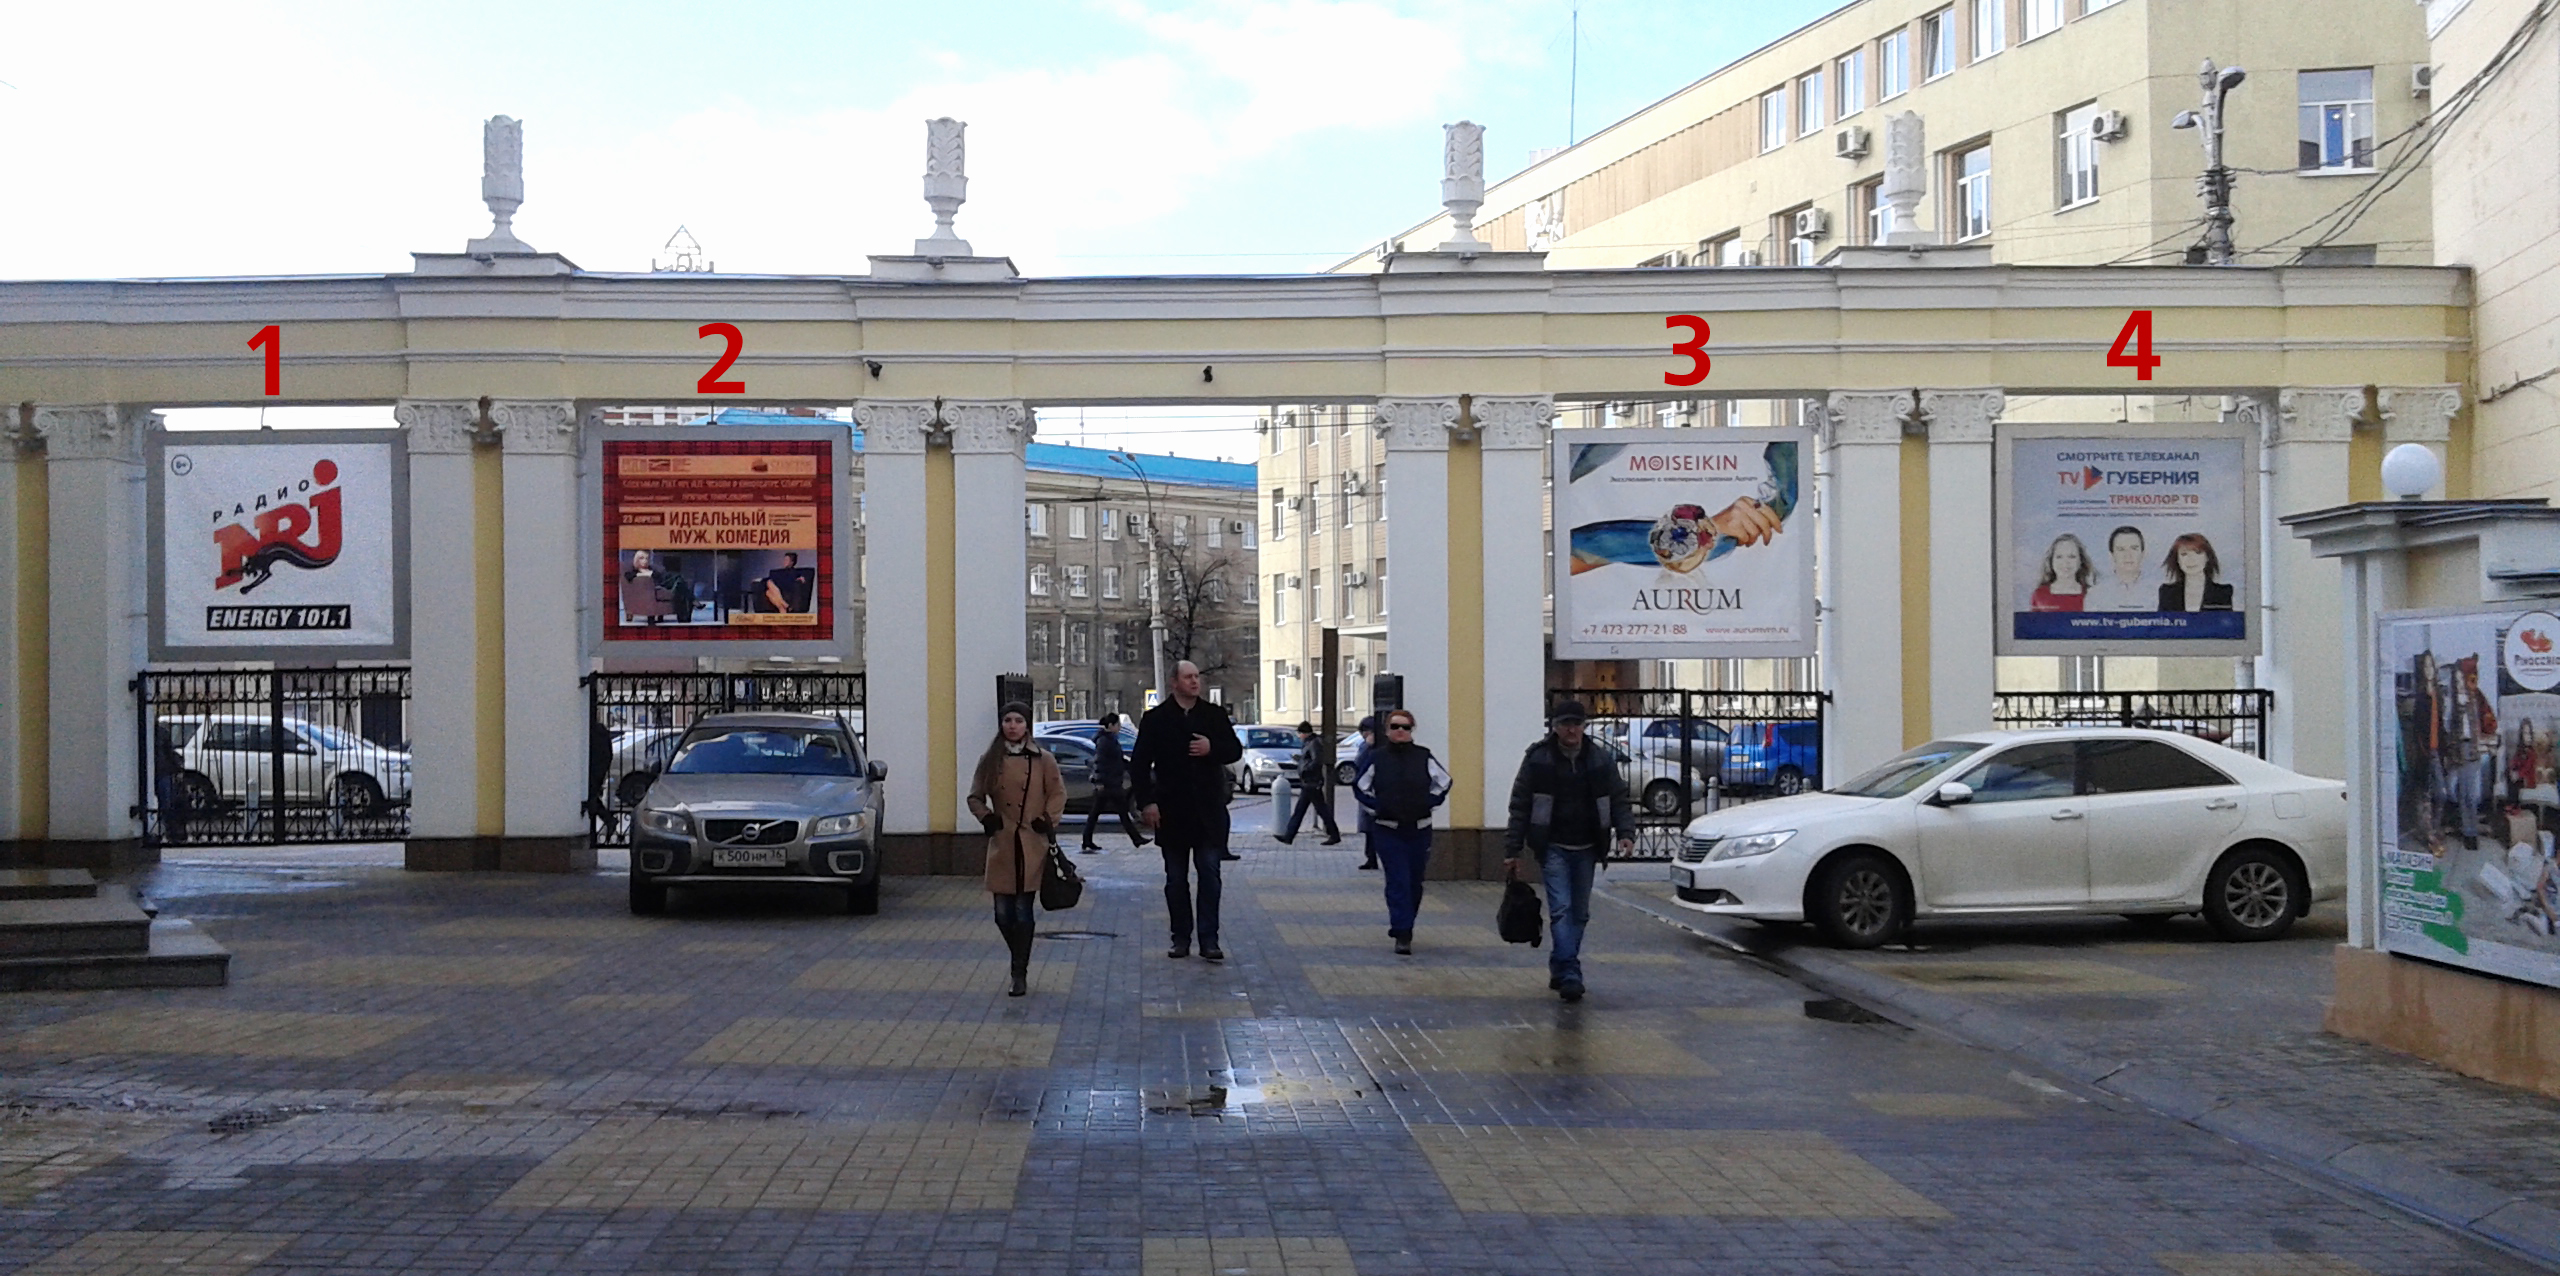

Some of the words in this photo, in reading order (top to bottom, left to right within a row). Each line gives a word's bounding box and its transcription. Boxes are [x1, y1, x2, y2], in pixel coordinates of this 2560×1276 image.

[1629, 454, 1738, 472] MOISEIKIN
[2057, 451, 2125, 462] СМОТРИТЕ
[2127, 451, 2200, 462] ТЕЛЕКАНАЛ
[2057, 471, 2081, 485] TV
[2106, 470, 2200, 485] ГУБЕРНИЯ
[212, 479, 310, 523] РАДИО
[2109, 494, 2179, 505] ТРИКОЛОР
[2183, 494, 2200, 505] ТВ
[213, 459, 342, 591] NRJ
[623, 514, 633, 524] 23
[669, 508, 766, 528] ИДЕАЛЬНЫЙ
[669, 529, 711, 544] МУЖ.
[716, 529, 790, 546] КОМЕДИЯ
[1632, 588, 1743, 616] AURUM
[209, 608, 292, 628] ENERGY
[298, 607, 348, 628] 101.1
[2070, 616, 2188, 629] www.tv-gubernia.ru
[1582, 624, 1596, 635] +7
[1600, 624, 1623, 635] 473
[1627, 624, 1688, 635] 277-21-88
